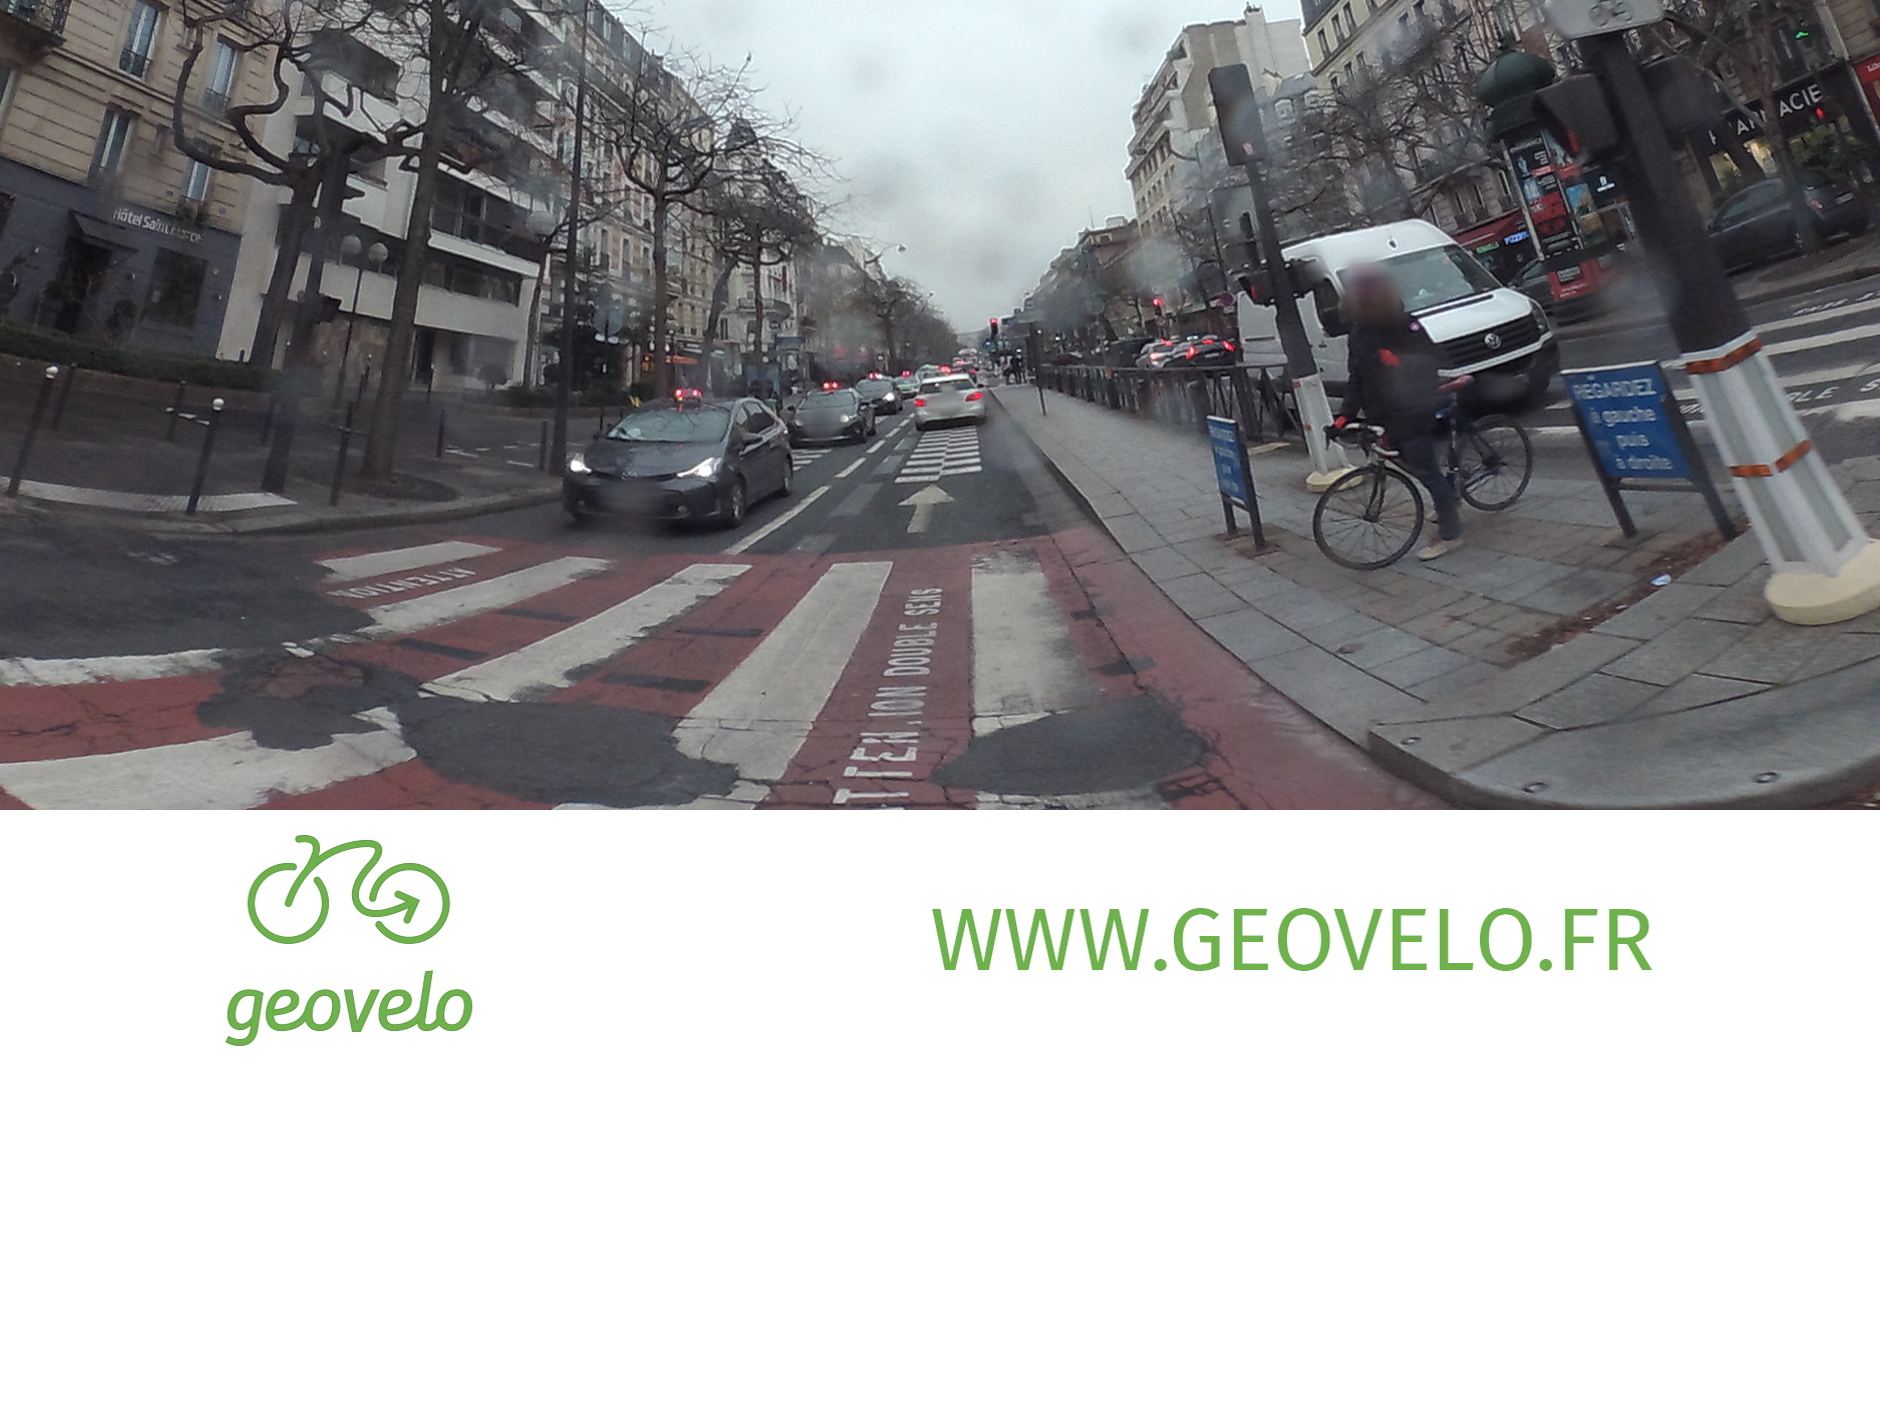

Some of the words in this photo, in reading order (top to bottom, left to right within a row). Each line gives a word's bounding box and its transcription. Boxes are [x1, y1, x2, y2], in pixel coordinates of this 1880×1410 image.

[1708, 83, 1822, 147] ARACIE
[1572, 378, 1658, 401] REGARDEZ
[1601, 405, 1658, 428] gauche
[1616, 433, 1651, 450] puis
[1627, 453, 1674, 471] droite
[903, 587, 943, 616] SENS
[882, 621, 939, 677] DOUBLE
[832, 685, 928, 810] TTENION
